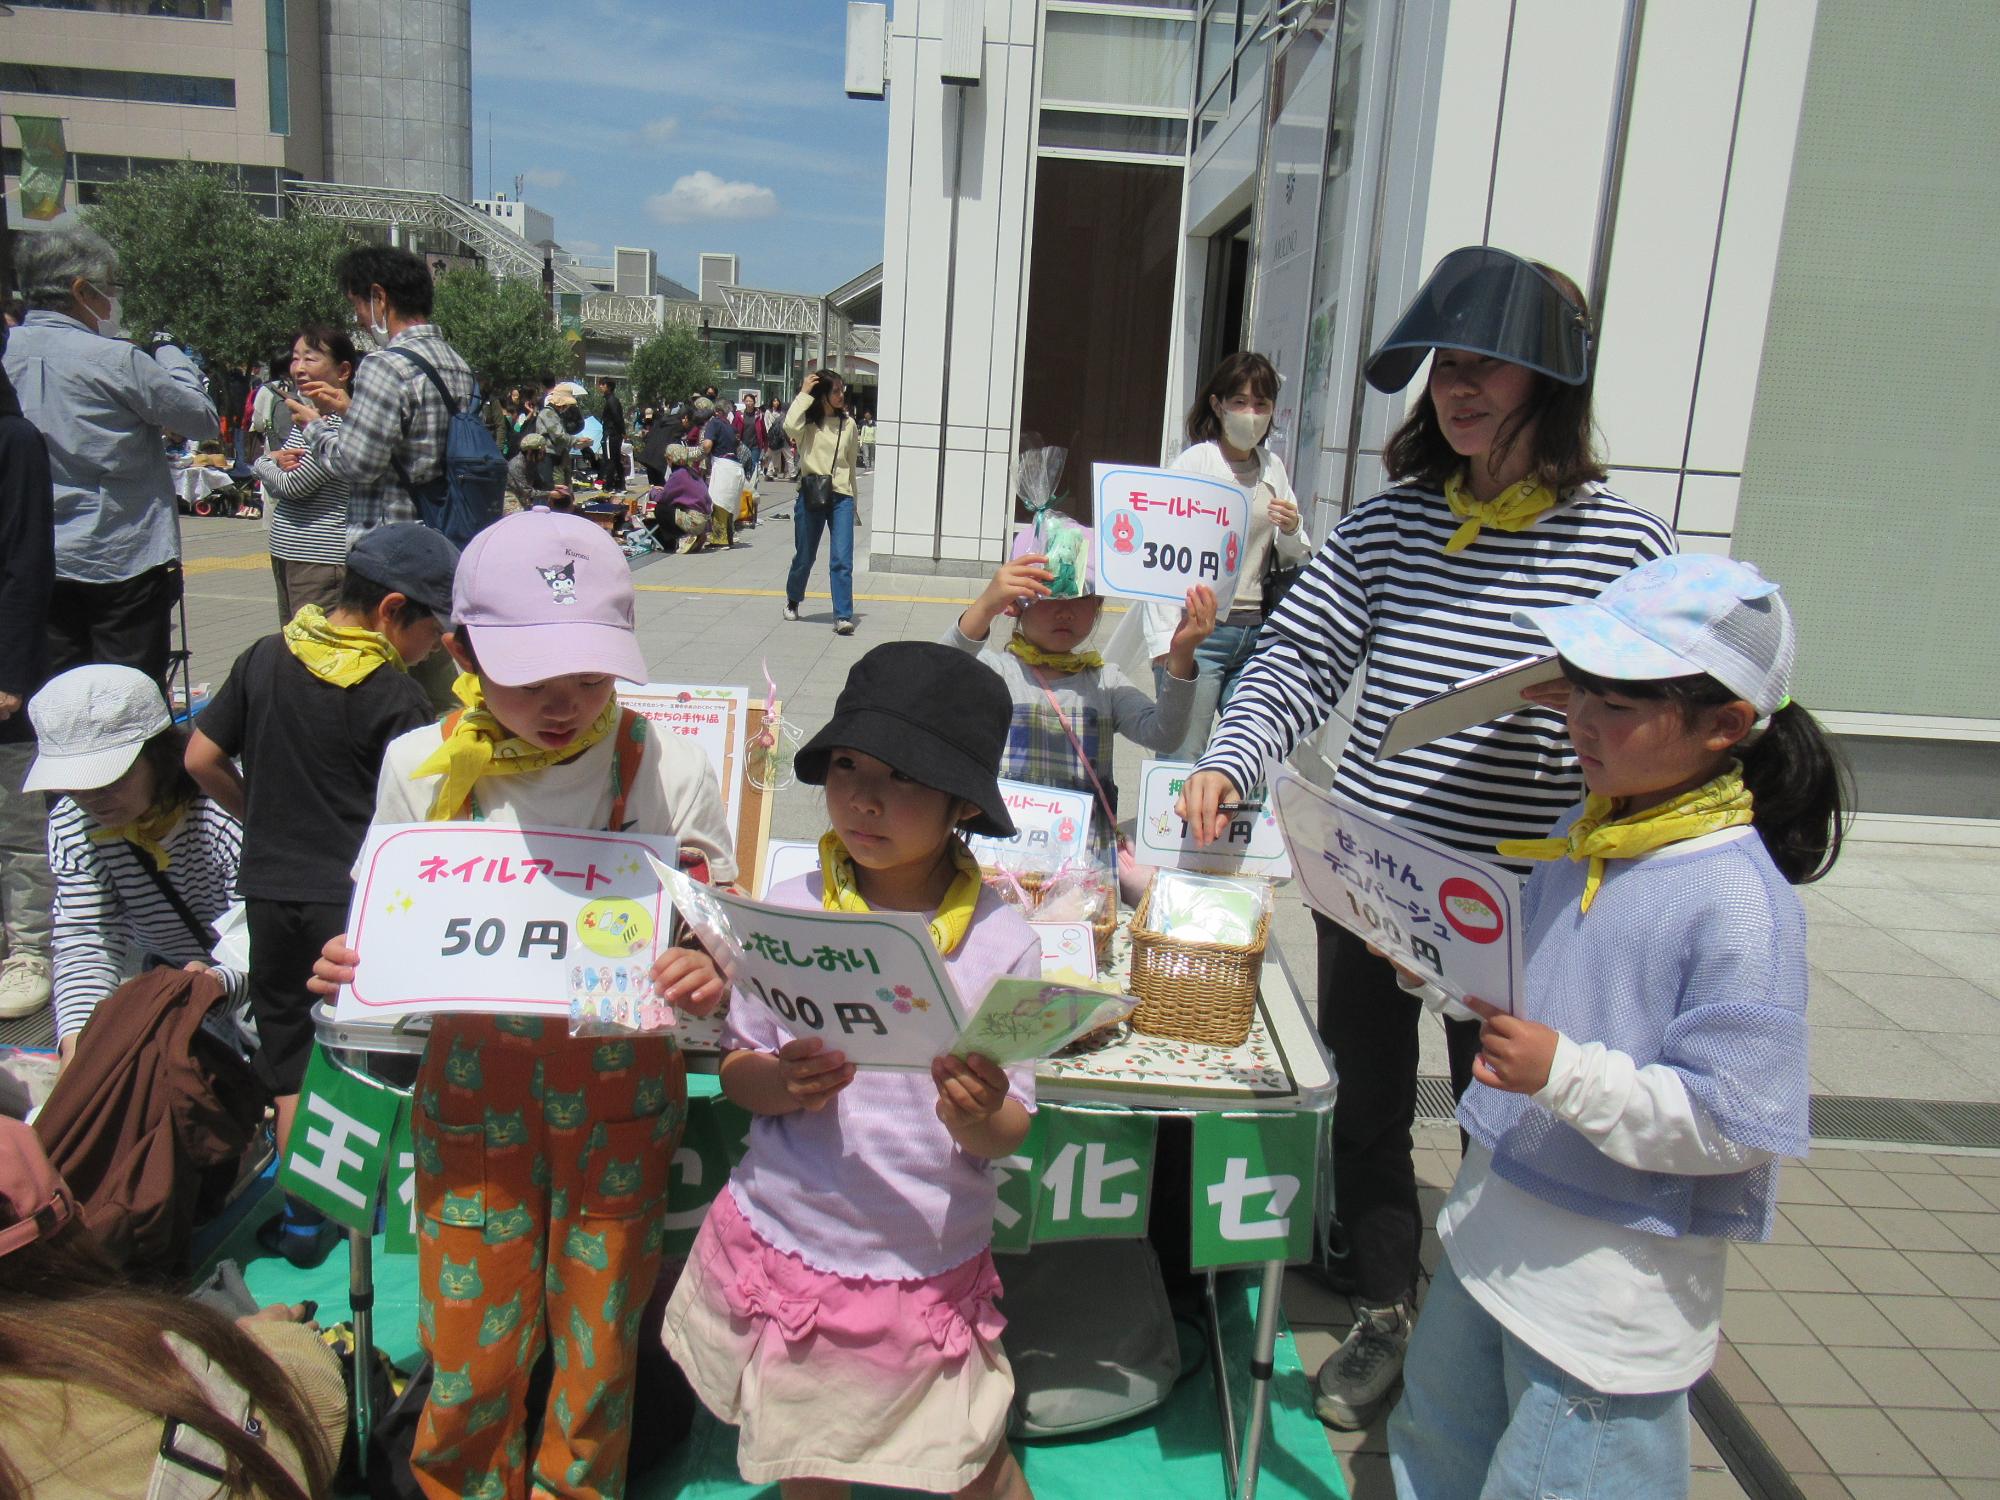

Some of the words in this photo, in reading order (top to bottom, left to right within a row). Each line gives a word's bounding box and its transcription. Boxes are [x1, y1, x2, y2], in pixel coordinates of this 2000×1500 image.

[1128, 490, 1231, 527] モールドール
[565, 548, 590, 560] Kuromi
[1142, 540, 1193, 571] 300
[1199, 550, 1219, 581] 円
[1003, 794, 1063, 815] ルドール
[417, 855, 612, 890] ネイルアート
[1335, 828, 1424, 892] せっけん
[441, 917, 505, 957] 50
[517, 919, 567, 961] 円
[742, 931, 881, 975] 花しおり
[1345, 890, 1401, 945] 100
[1410, 934, 1443, 976] 円
[751, 976, 824, 1031] 100
[833, 1002, 888, 1035] 円
